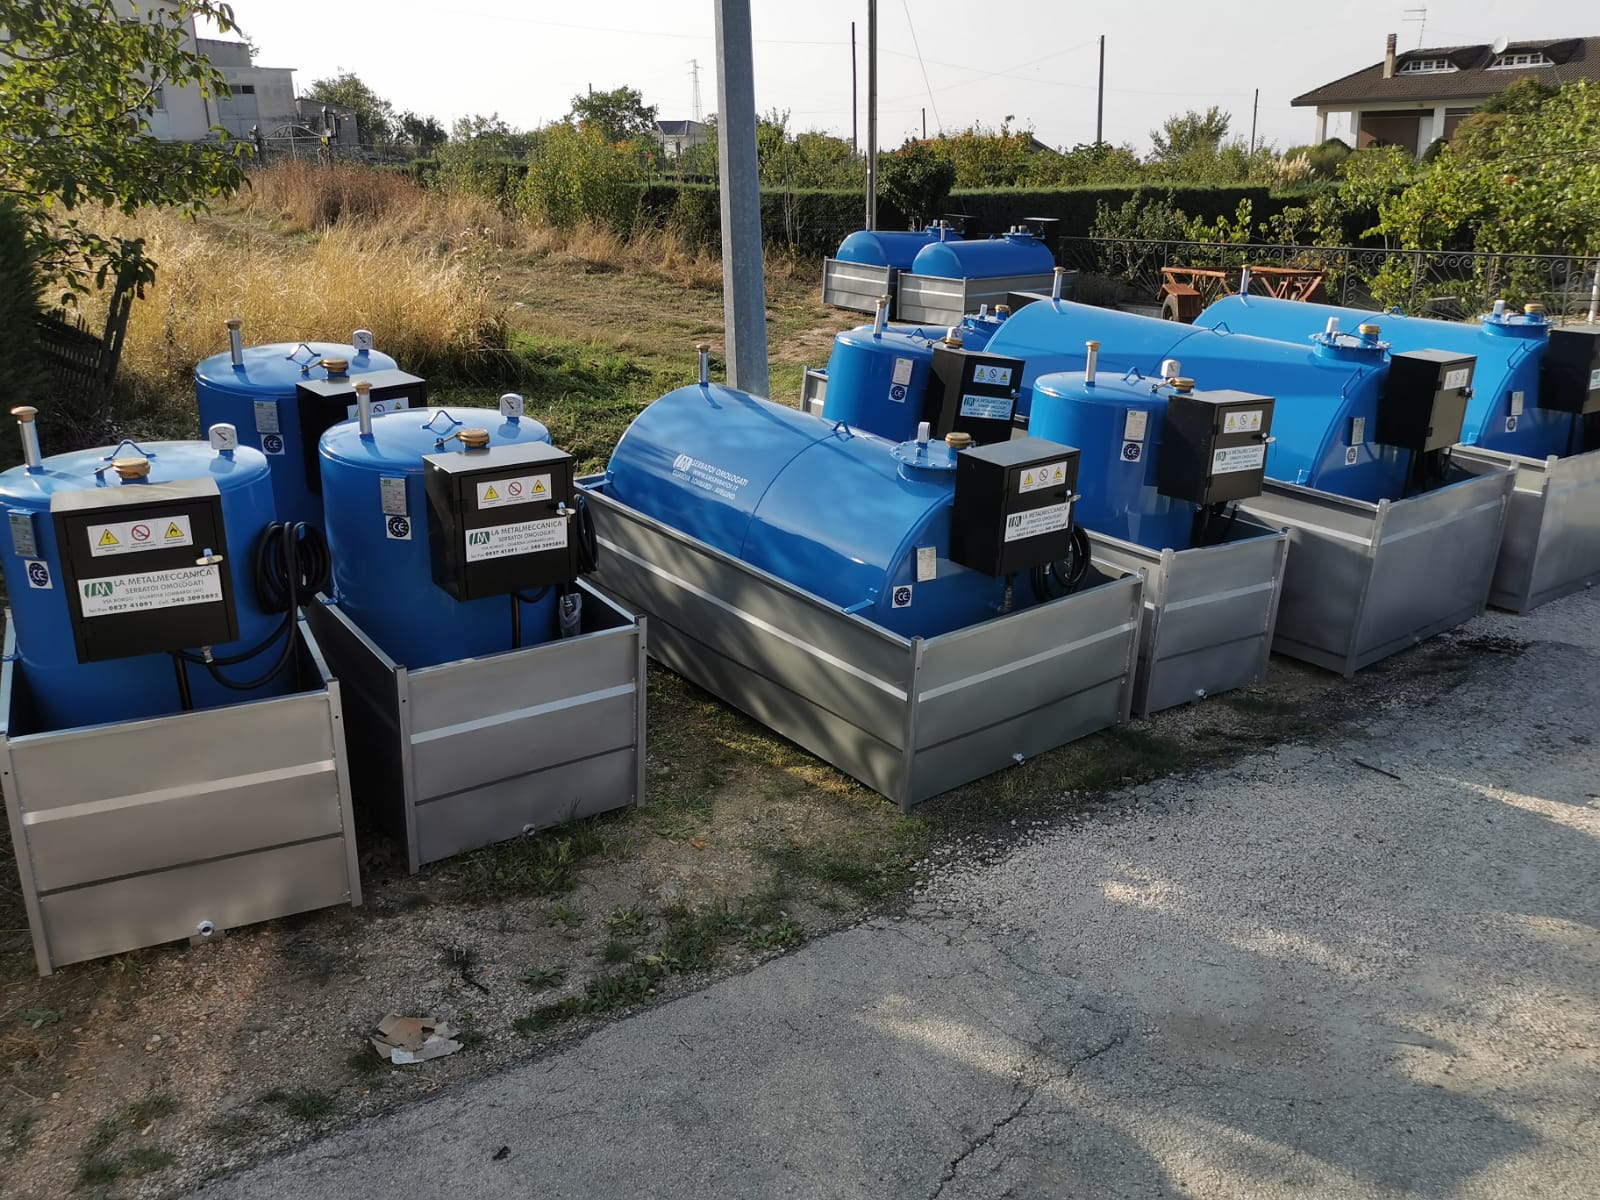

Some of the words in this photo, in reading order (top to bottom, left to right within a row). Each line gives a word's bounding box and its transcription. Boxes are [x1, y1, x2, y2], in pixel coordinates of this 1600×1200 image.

[490, 528, 499, 536] LA
[500, 520, 561, 534] METALMECCANICA
[113, 578, 125, 587] LA
[127, 568, 212, 585] METALMECCANICA
[125, 584, 159, 594] SERBATOI
[160, 579, 204, 590] OMOLOGATI
[129, 600, 152, 608] 41091
